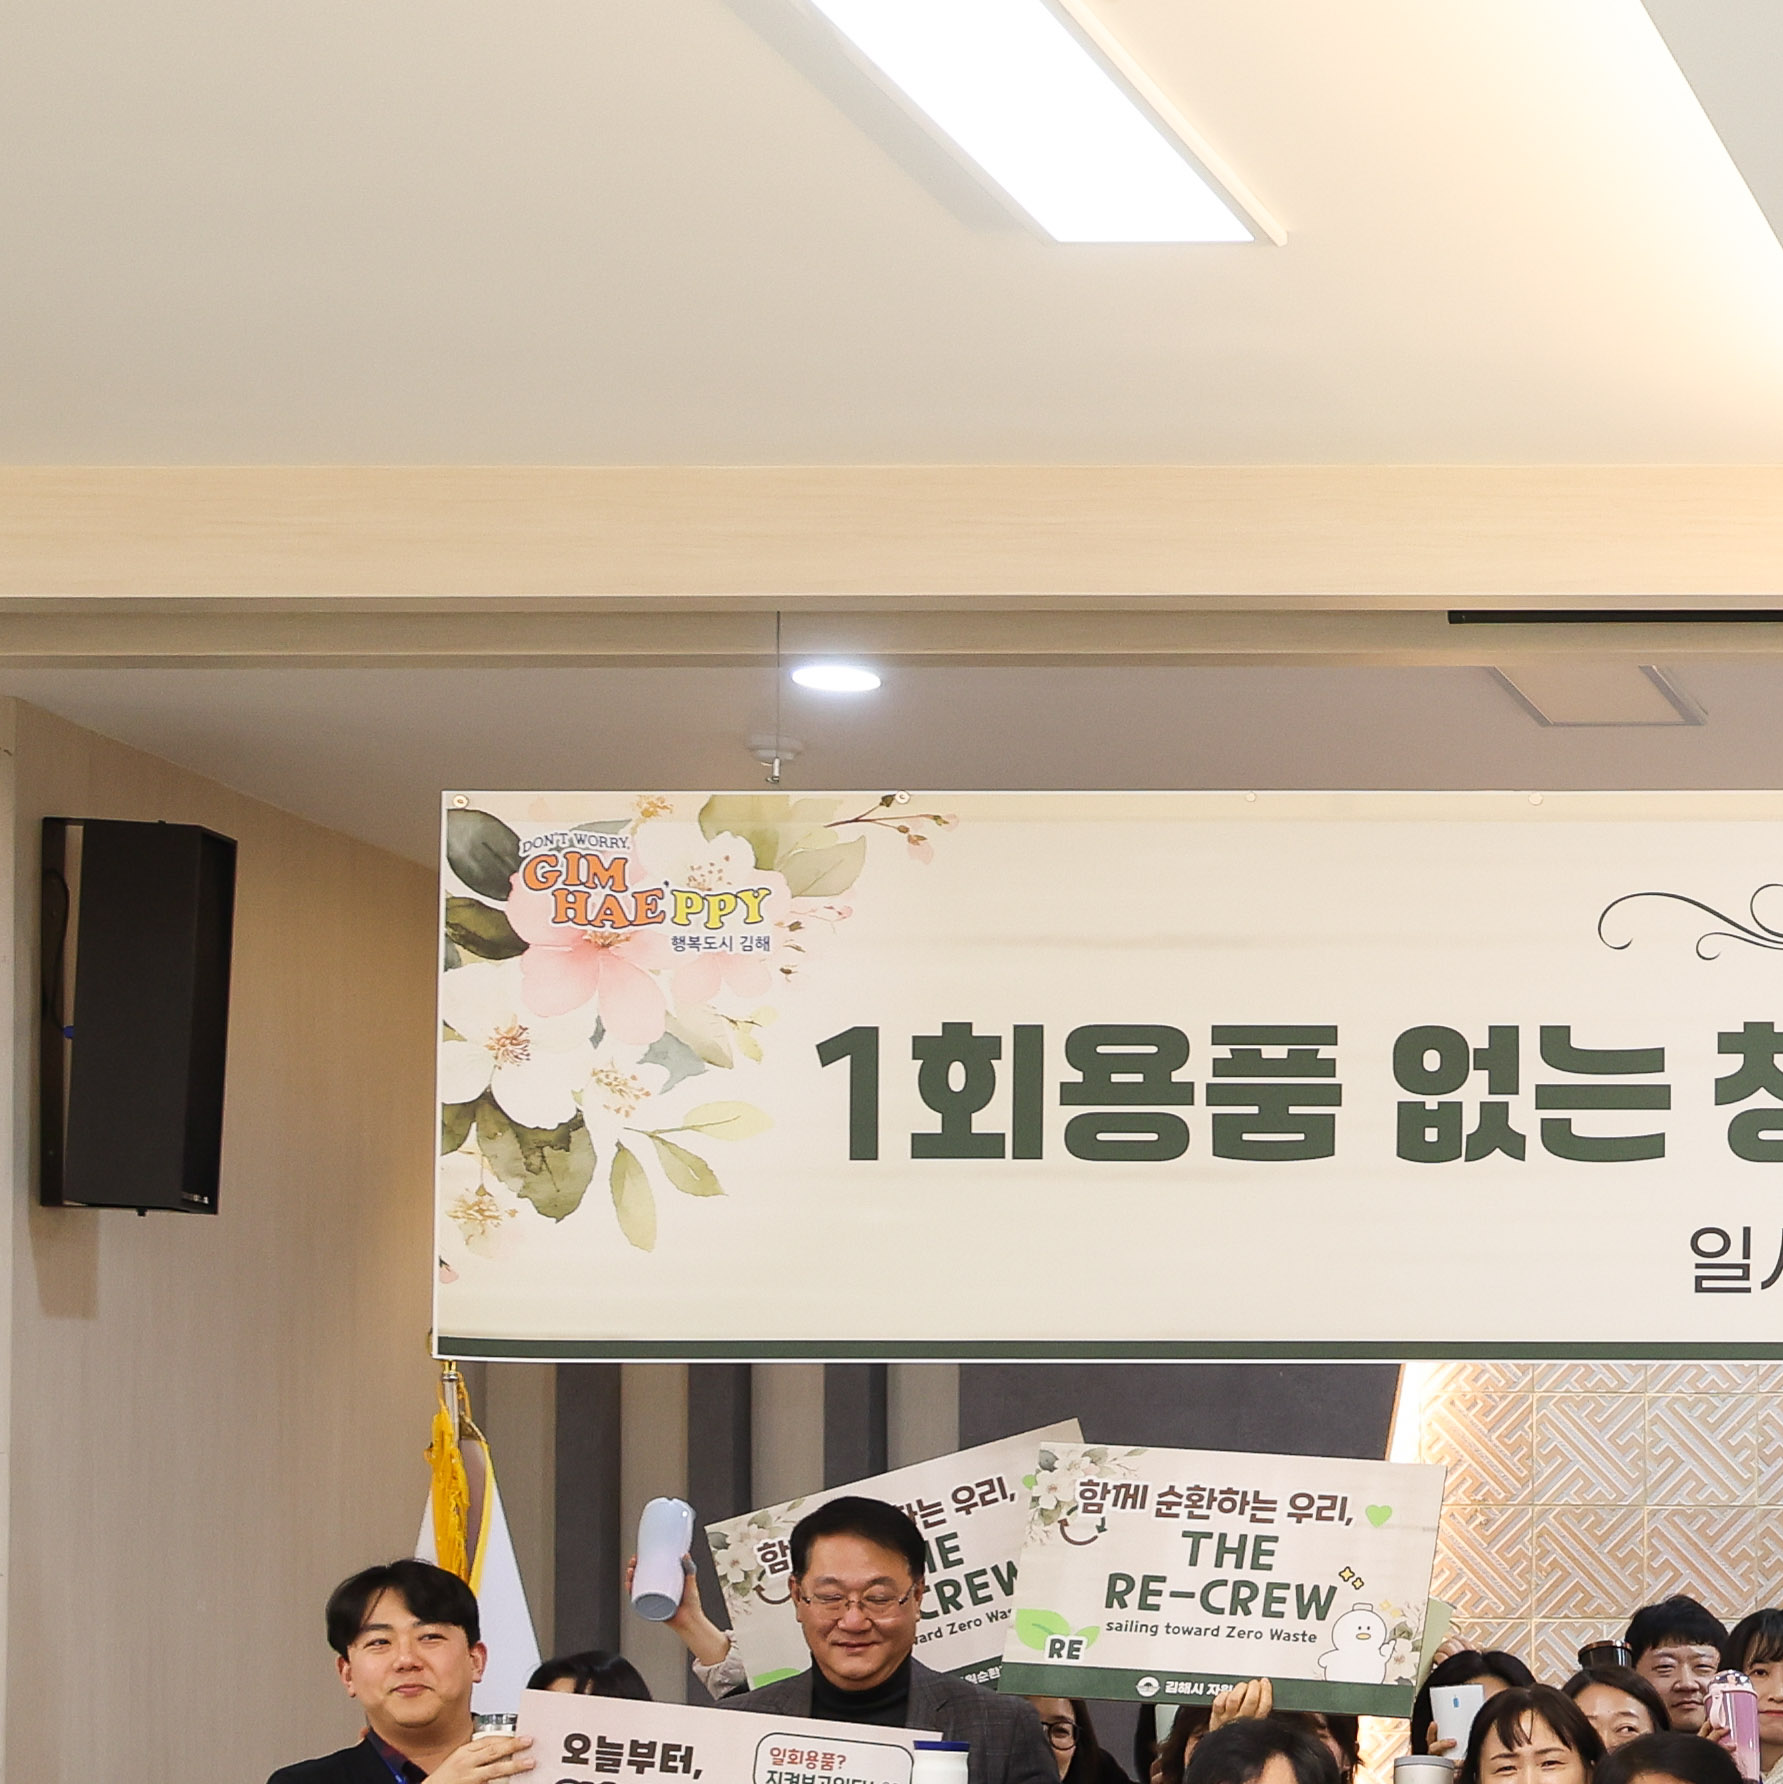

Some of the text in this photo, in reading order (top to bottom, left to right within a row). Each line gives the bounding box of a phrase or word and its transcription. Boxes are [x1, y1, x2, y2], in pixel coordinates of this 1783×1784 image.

[523, 851, 629, 892] GIM
[671, 935, 771, 952] 행복도시 김해
[815, 1022, 1344, 1163] 1회용품
[1391, 1023, 1673, 1165] 없는
[951, 1476, 1016, 1516] 우리,
[1078, 1479, 1353, 1527] 함께 순환하는 우리,
[1182, 1530, 1280, 1572] THE
[1104, 1572, 1338, 1622] RE-CREW
[946, 1617, 982, 1636] Zero
[1105, 1619, 1318, 1644] sailing toward Zero Waste
[1048, 1637, 1083, 1661] RE
[1164, 1680, 1204, 1696] 김해시
[561, 1731, 703, 1780] 오늘부터,
[769, 1745, 847, 1773] 일회용품?
